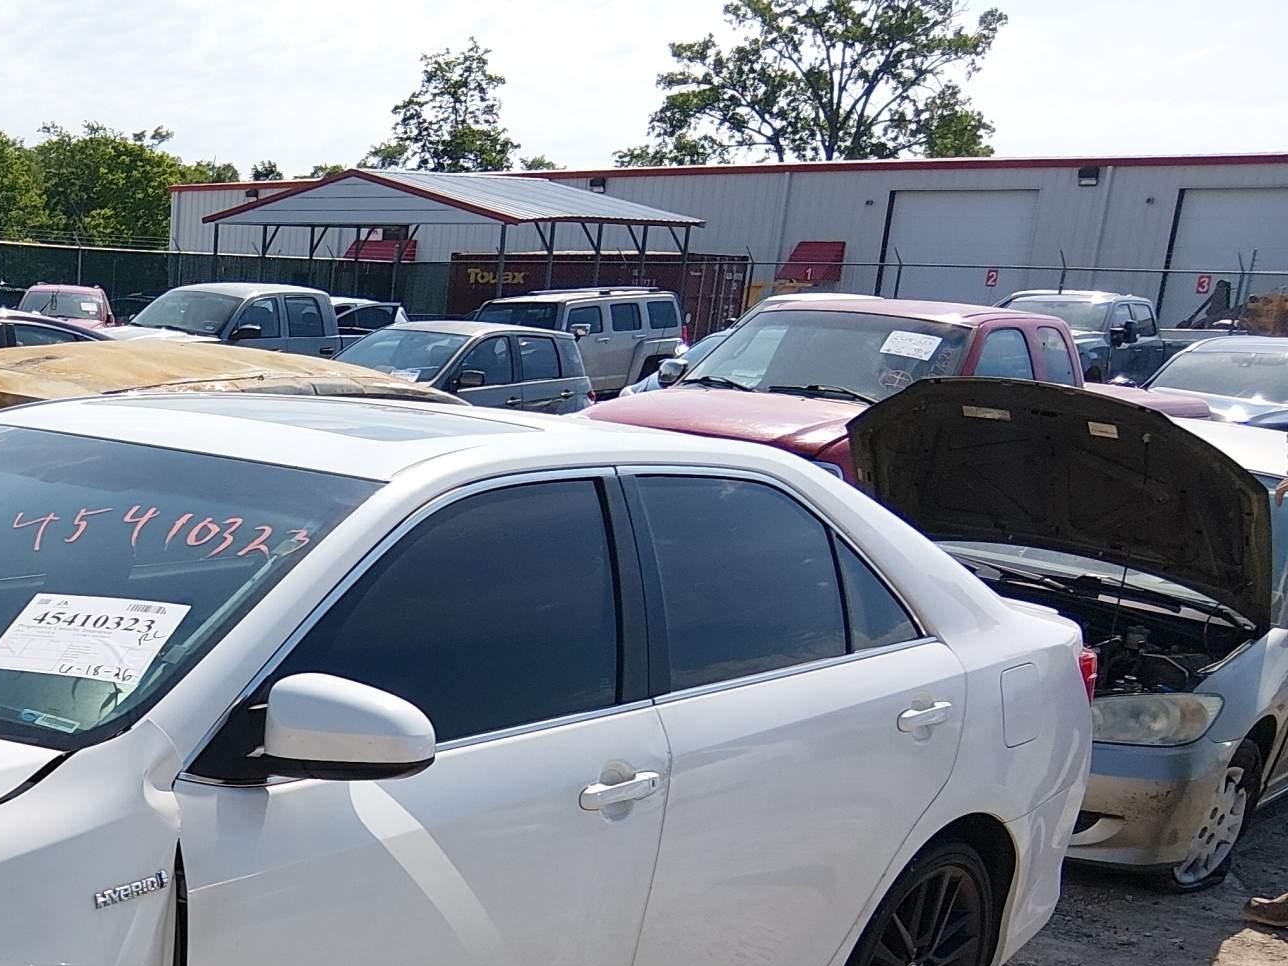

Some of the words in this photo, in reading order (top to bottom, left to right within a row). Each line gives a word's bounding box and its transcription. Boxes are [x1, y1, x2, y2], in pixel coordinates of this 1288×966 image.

[805, 267, 812, 281] 1
[987, 271, 997, 286] 2
[1198, 277, 1209, 292] 3
[32, 610, 157, 634] 45410323
[94, 874, 160, 909] HYBRID
